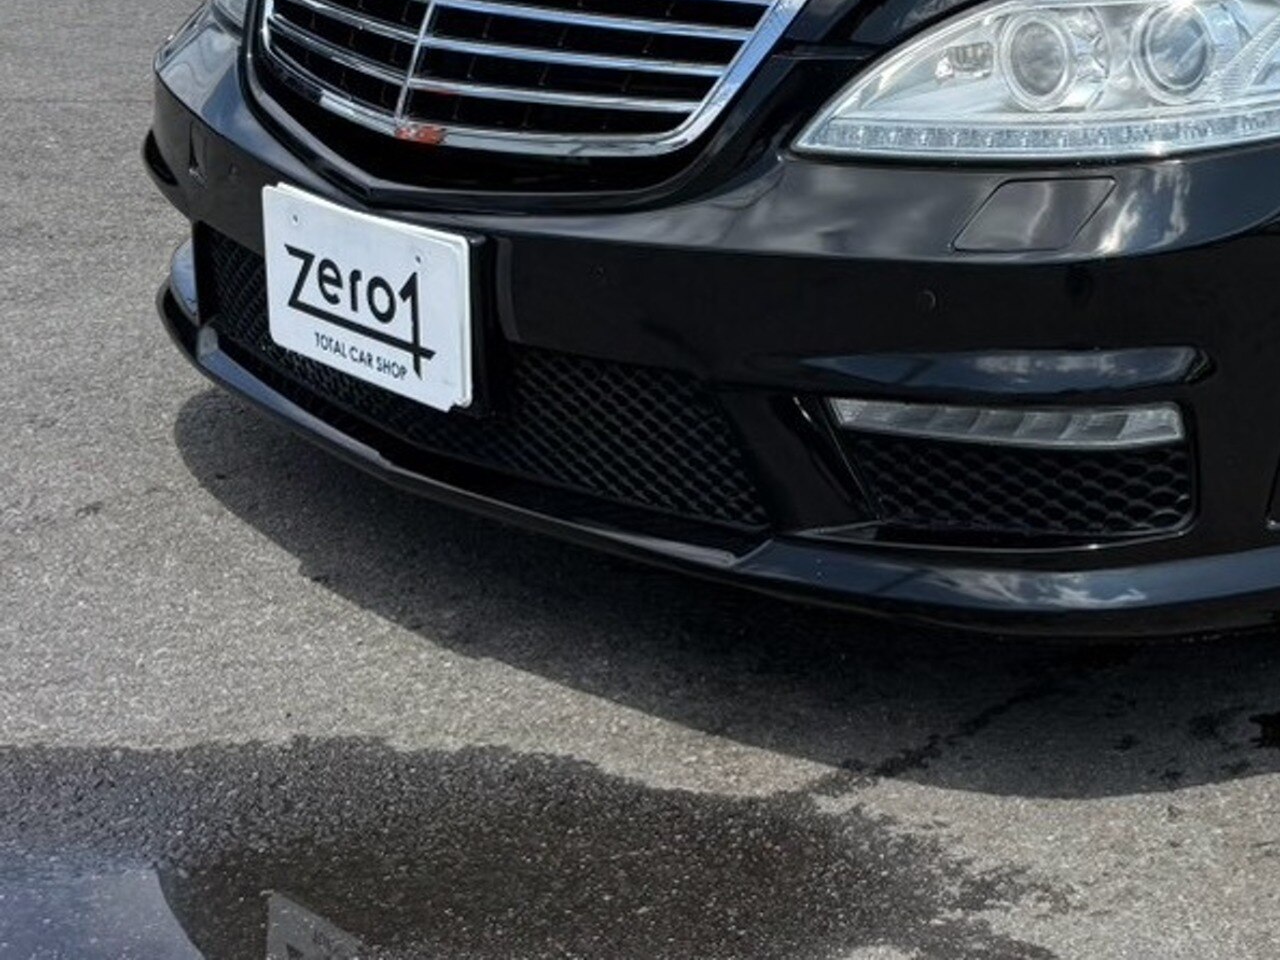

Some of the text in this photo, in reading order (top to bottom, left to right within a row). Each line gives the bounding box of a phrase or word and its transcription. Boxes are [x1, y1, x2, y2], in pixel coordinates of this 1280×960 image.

[314, 332, 409, 381] TOTAL CAR SHOP
